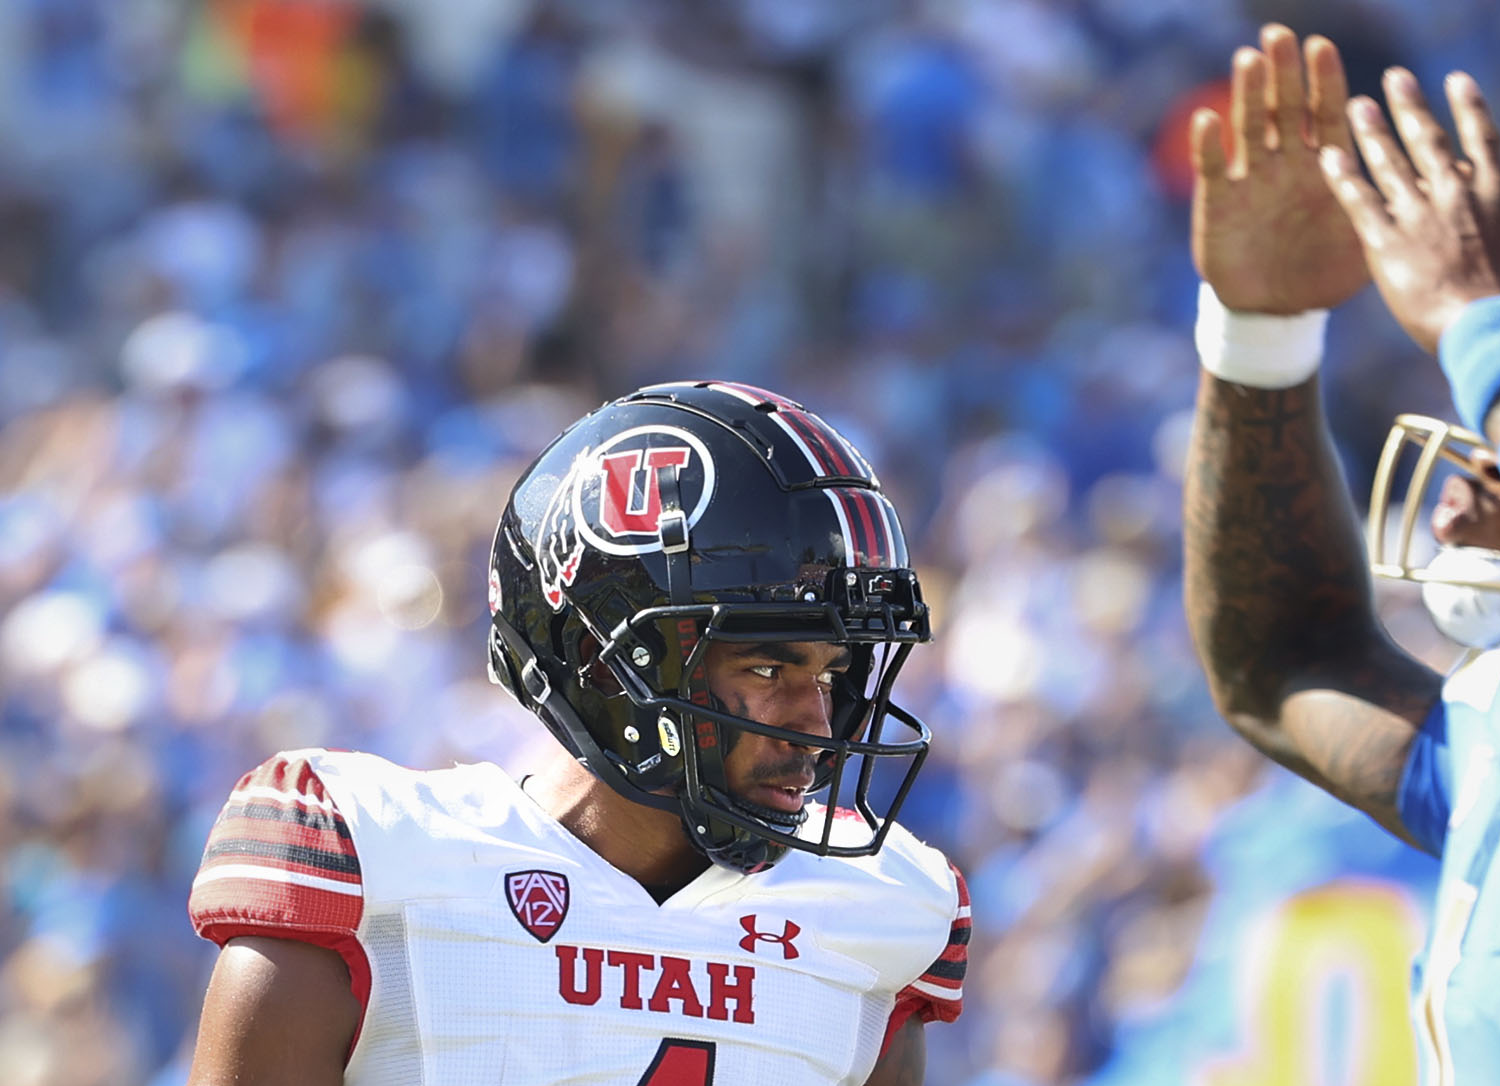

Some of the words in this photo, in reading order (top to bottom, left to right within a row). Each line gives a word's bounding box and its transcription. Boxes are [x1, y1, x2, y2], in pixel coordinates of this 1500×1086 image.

[599, 447, 691, 537] U
[508, 873, 567, 915] PAC
[525, 900, 557, 927] 12
[555, 945, 755, 1024] UTAH
